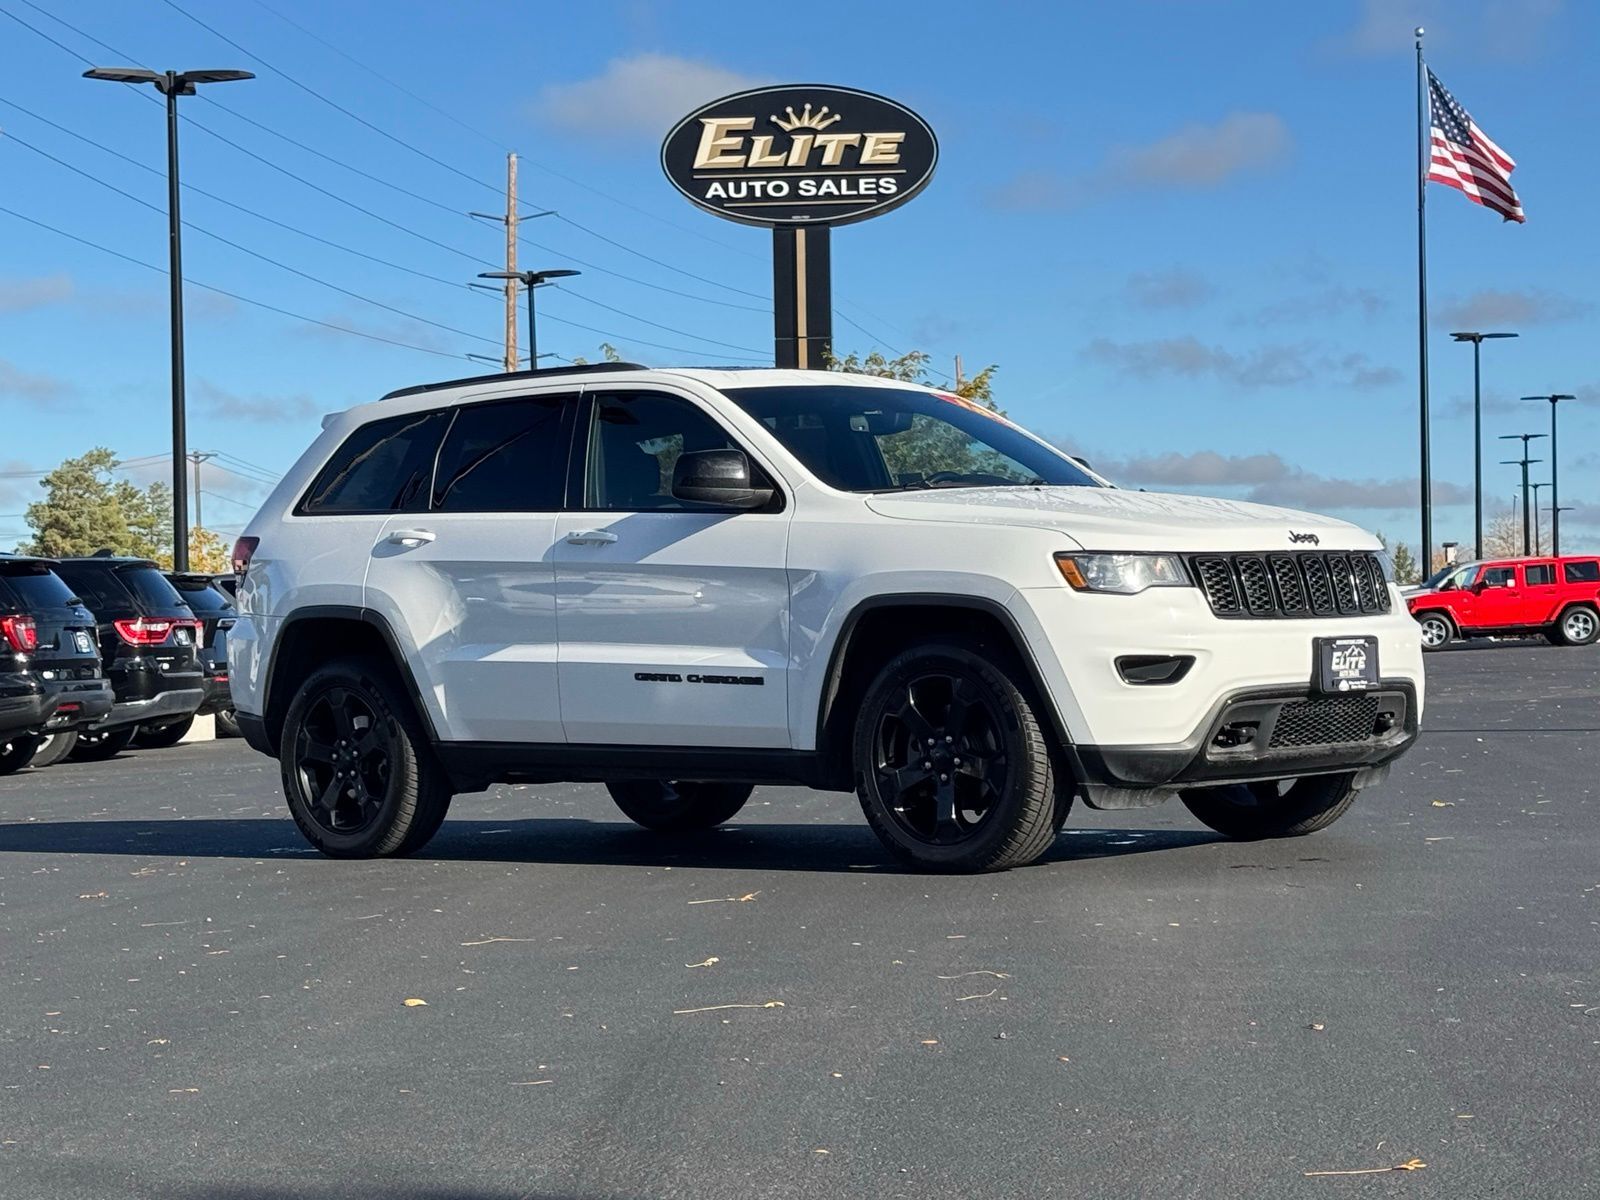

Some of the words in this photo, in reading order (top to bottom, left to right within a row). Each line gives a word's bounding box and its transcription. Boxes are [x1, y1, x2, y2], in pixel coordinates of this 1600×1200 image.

[692, 117, 906, 169] ELITE
[705, 180, 790, 200] AUTO
[797, 177, 898, 197] SALES
[1288, 530, 1320, 547] Jeep
